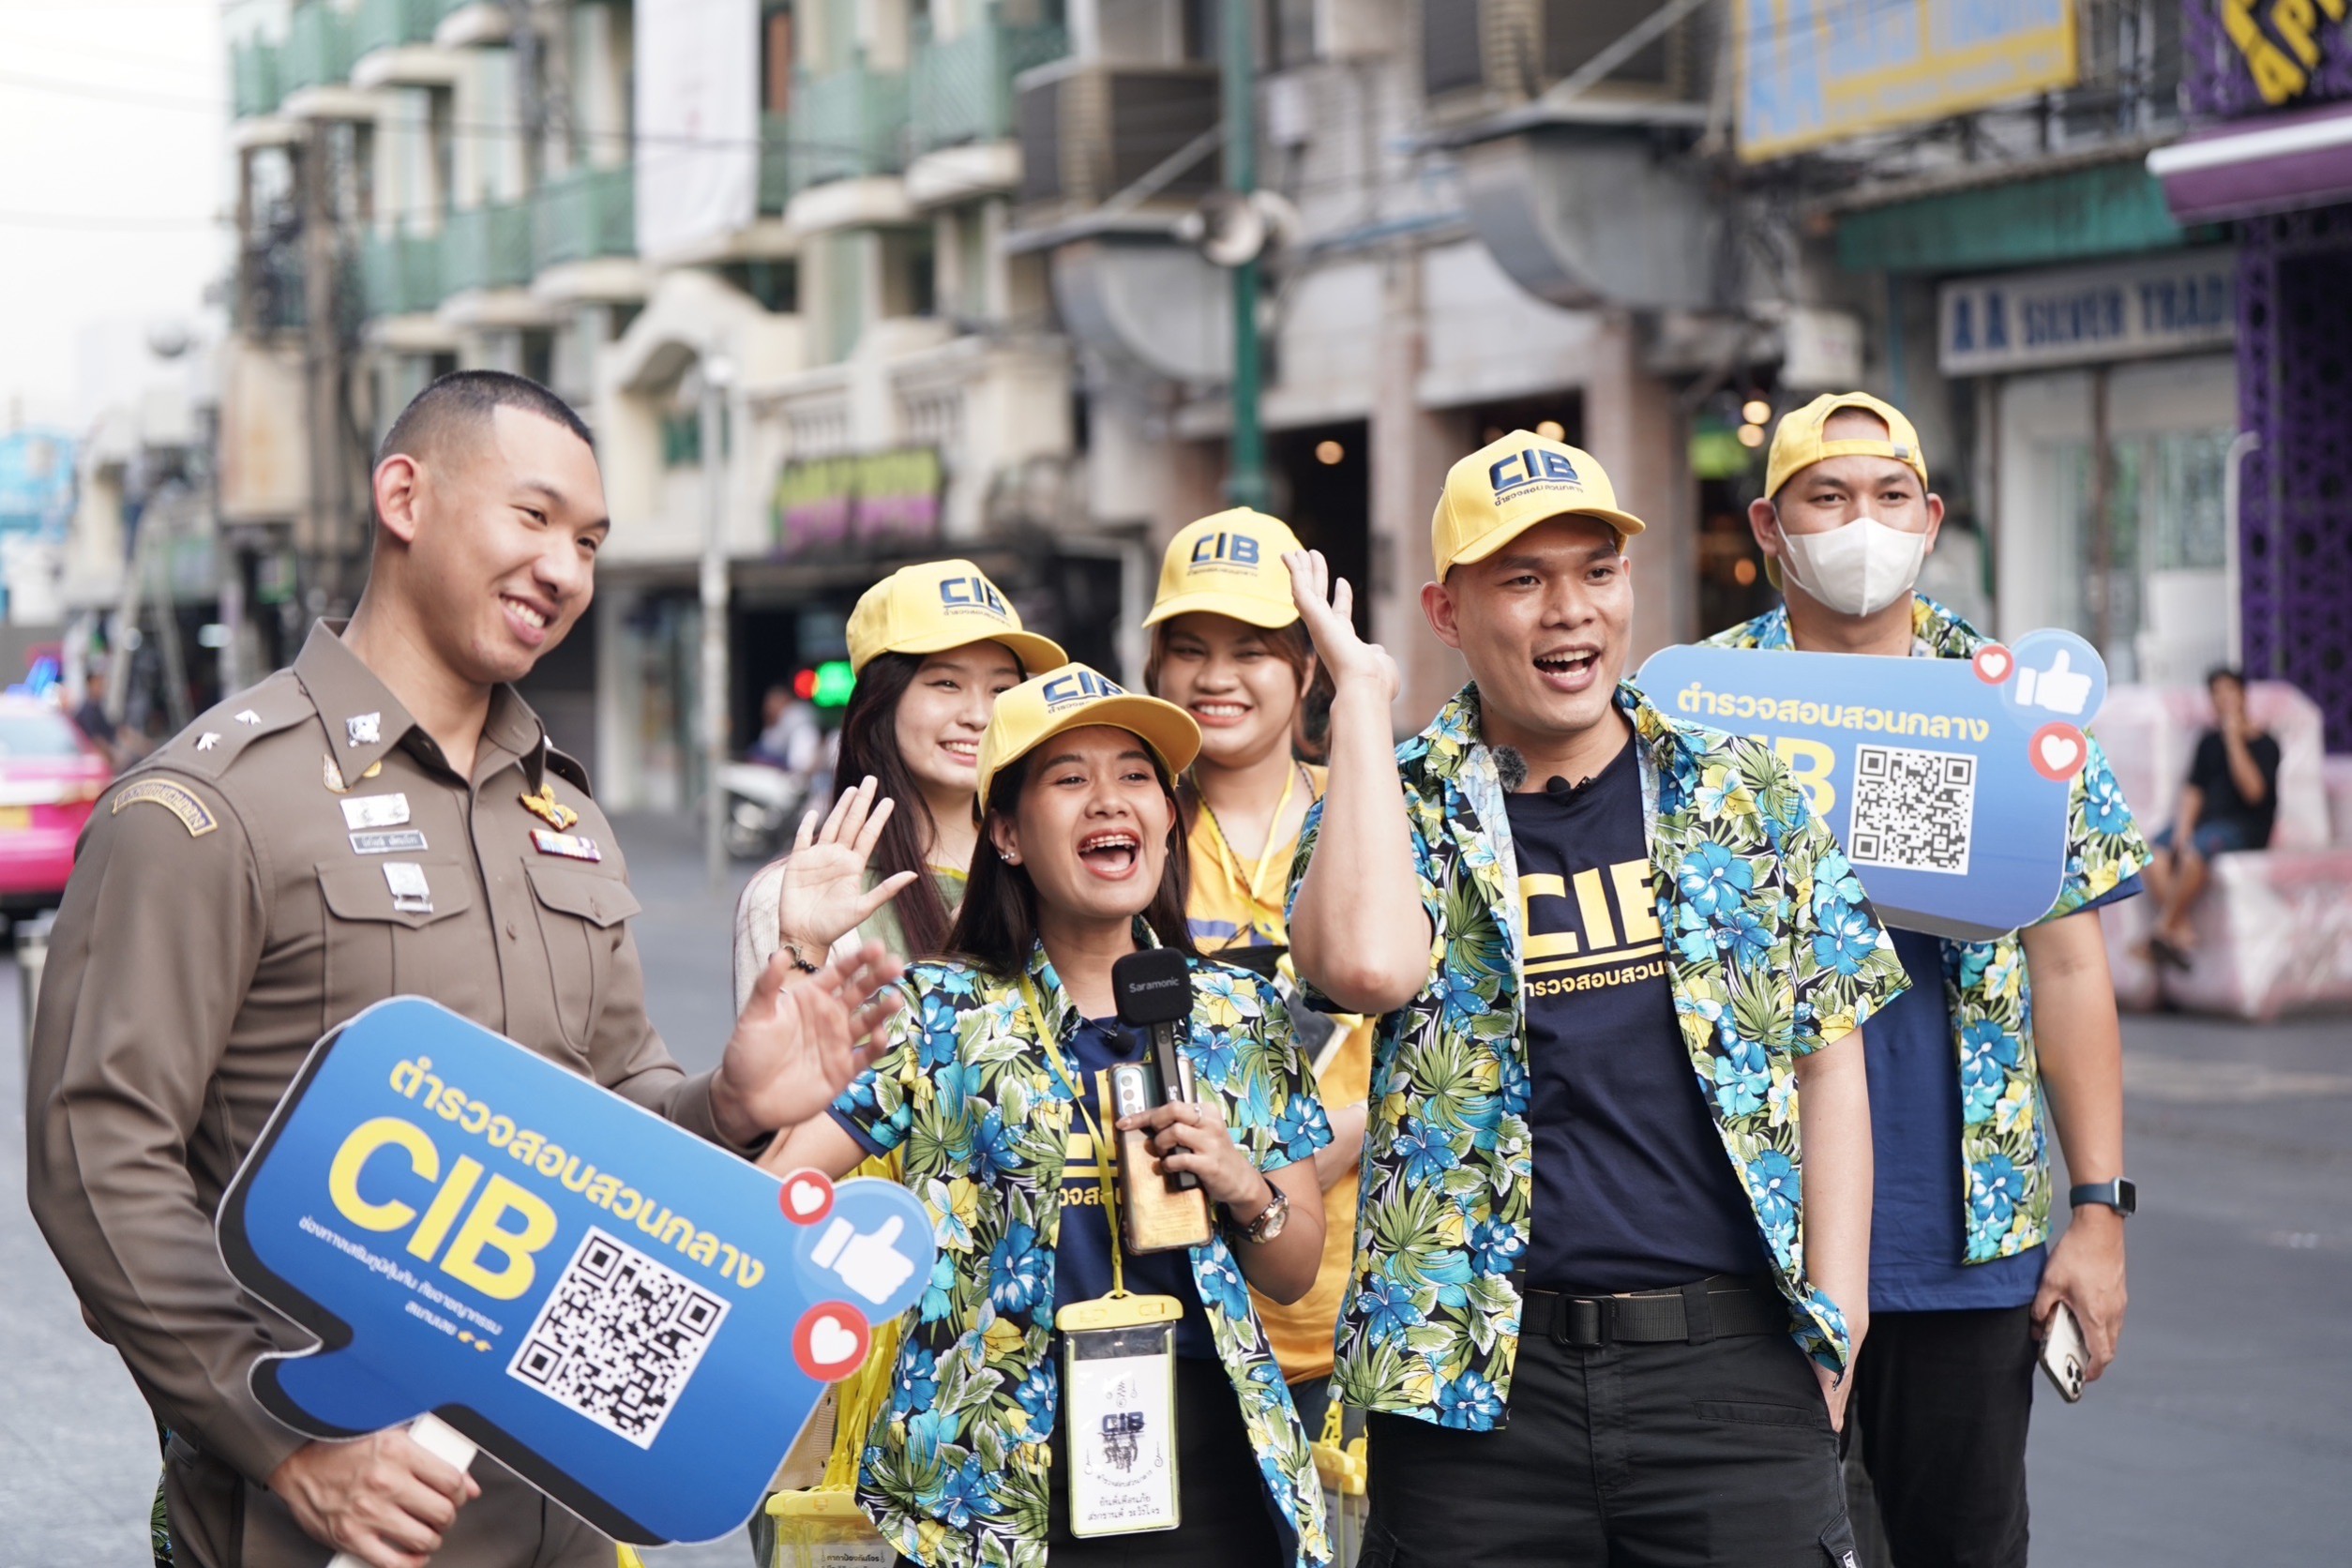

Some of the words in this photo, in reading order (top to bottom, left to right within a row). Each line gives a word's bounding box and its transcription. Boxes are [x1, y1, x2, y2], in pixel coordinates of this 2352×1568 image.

[1489, 449, 1578, 490] CIB
[1191, 532, 1259, 564] CIB
[940, 577, 1006, 615] CIB
[1678, 682, 1990, 742] ตำรวจสอบสวนกลาง
[1128, 976, 1180, 993] Saramonic
[389, 1056, 765, 1289] ตำรวจสอบสวนกลาง
[328, 1116, 558, 1300] CIB
[1102, 1411, 1145, 1433] CIB
